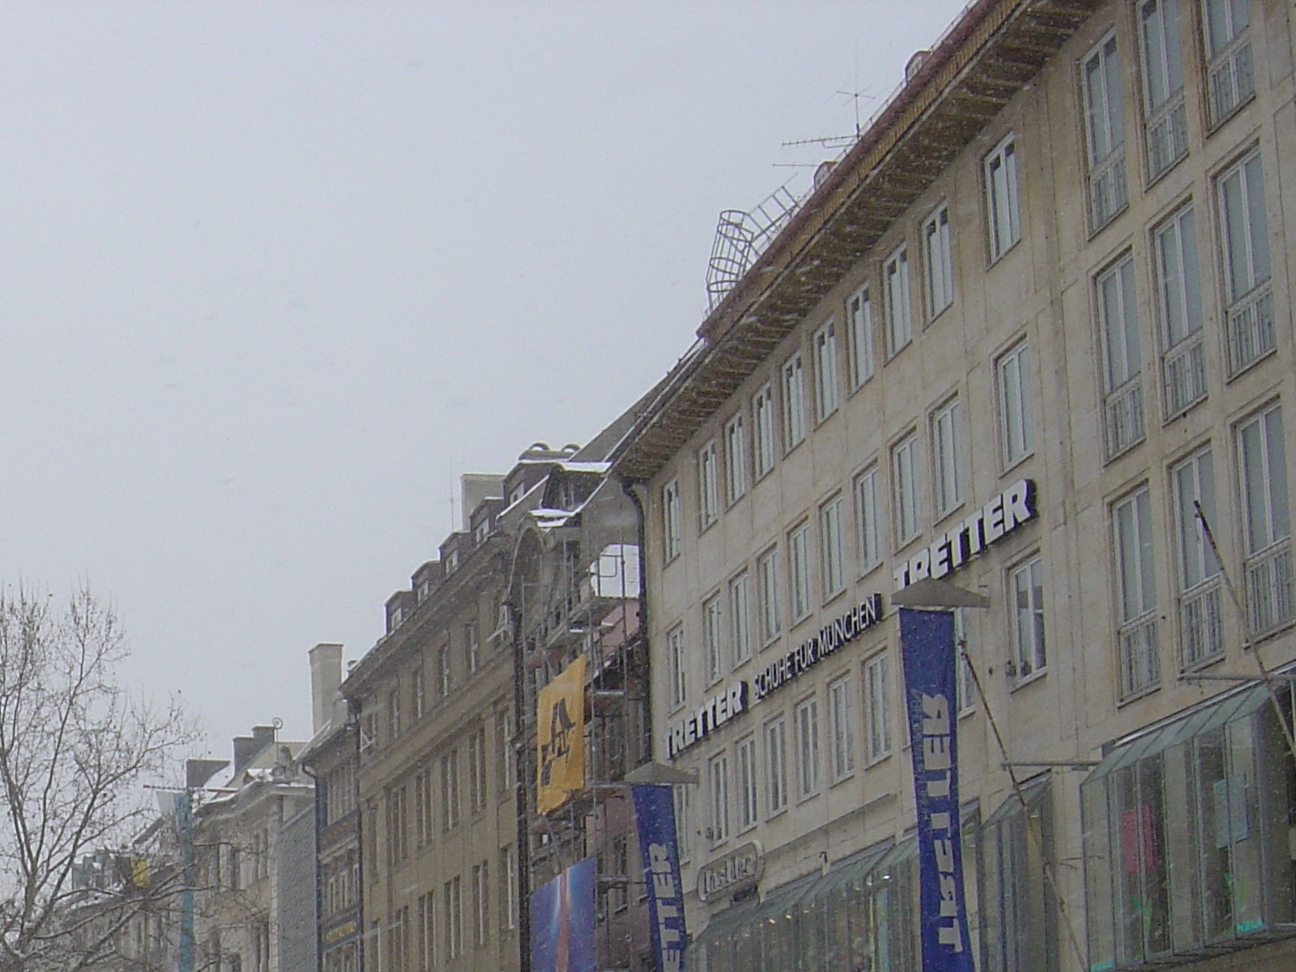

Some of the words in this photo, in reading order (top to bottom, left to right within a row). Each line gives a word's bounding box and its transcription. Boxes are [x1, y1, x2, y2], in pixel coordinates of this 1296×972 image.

[893, 478, 1033, 590] TRETTER
[664, 680, 747, 760] TRETTER
[754, 651, 794, 699] SCHUHE
